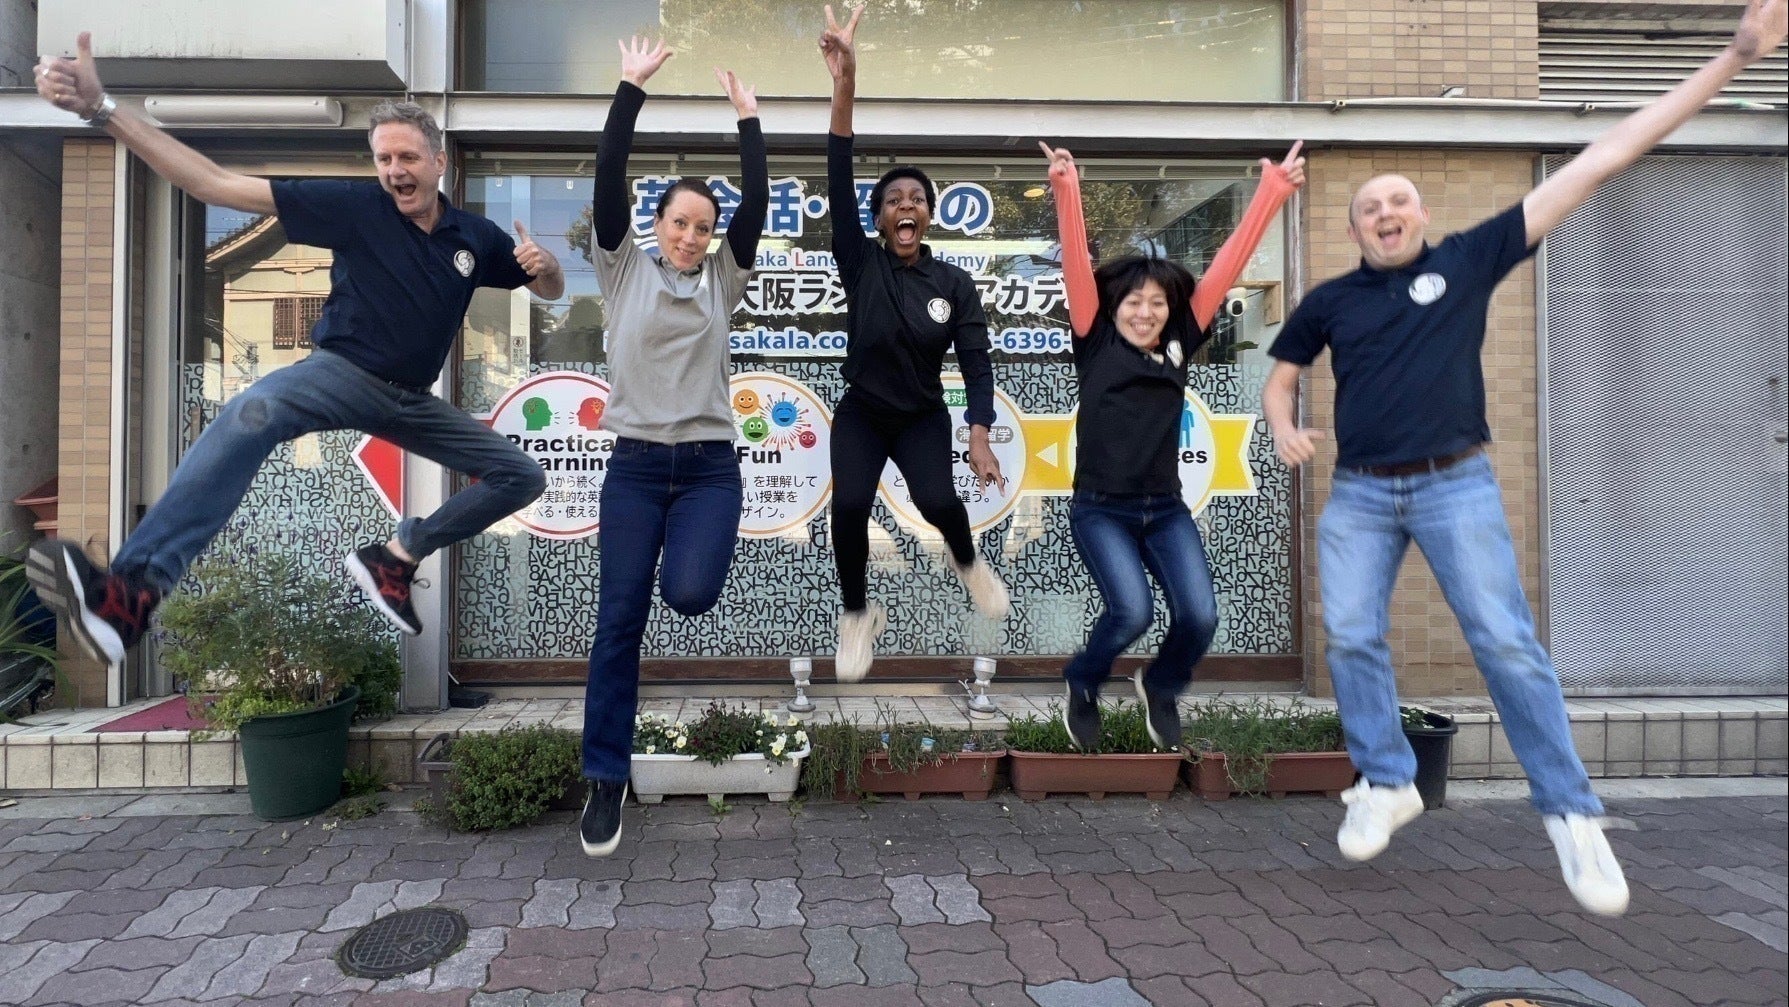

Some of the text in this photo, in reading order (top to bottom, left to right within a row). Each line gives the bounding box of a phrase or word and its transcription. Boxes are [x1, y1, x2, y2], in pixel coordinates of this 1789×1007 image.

[756, 251, 985, 271] aka Lang demy
[730, 331, 1070, 349] sakala.co -6396-
[960, 428, 1011, 441] 海留学
[506, 434, 615, 452] Practica
[737, 446, 781, 464] Fun
[538, 453, 611, 471] arnin
[546, 475, 604, 488] いから続く。
[742, 475, 817, 488] 』を理解して
[537, 490, 602, 503] 実践的な英
[743, 490, 798, 503] い授業を
[958, 490, 989, 503] 違う。
[742, 506, 785, 519] ザイン。
